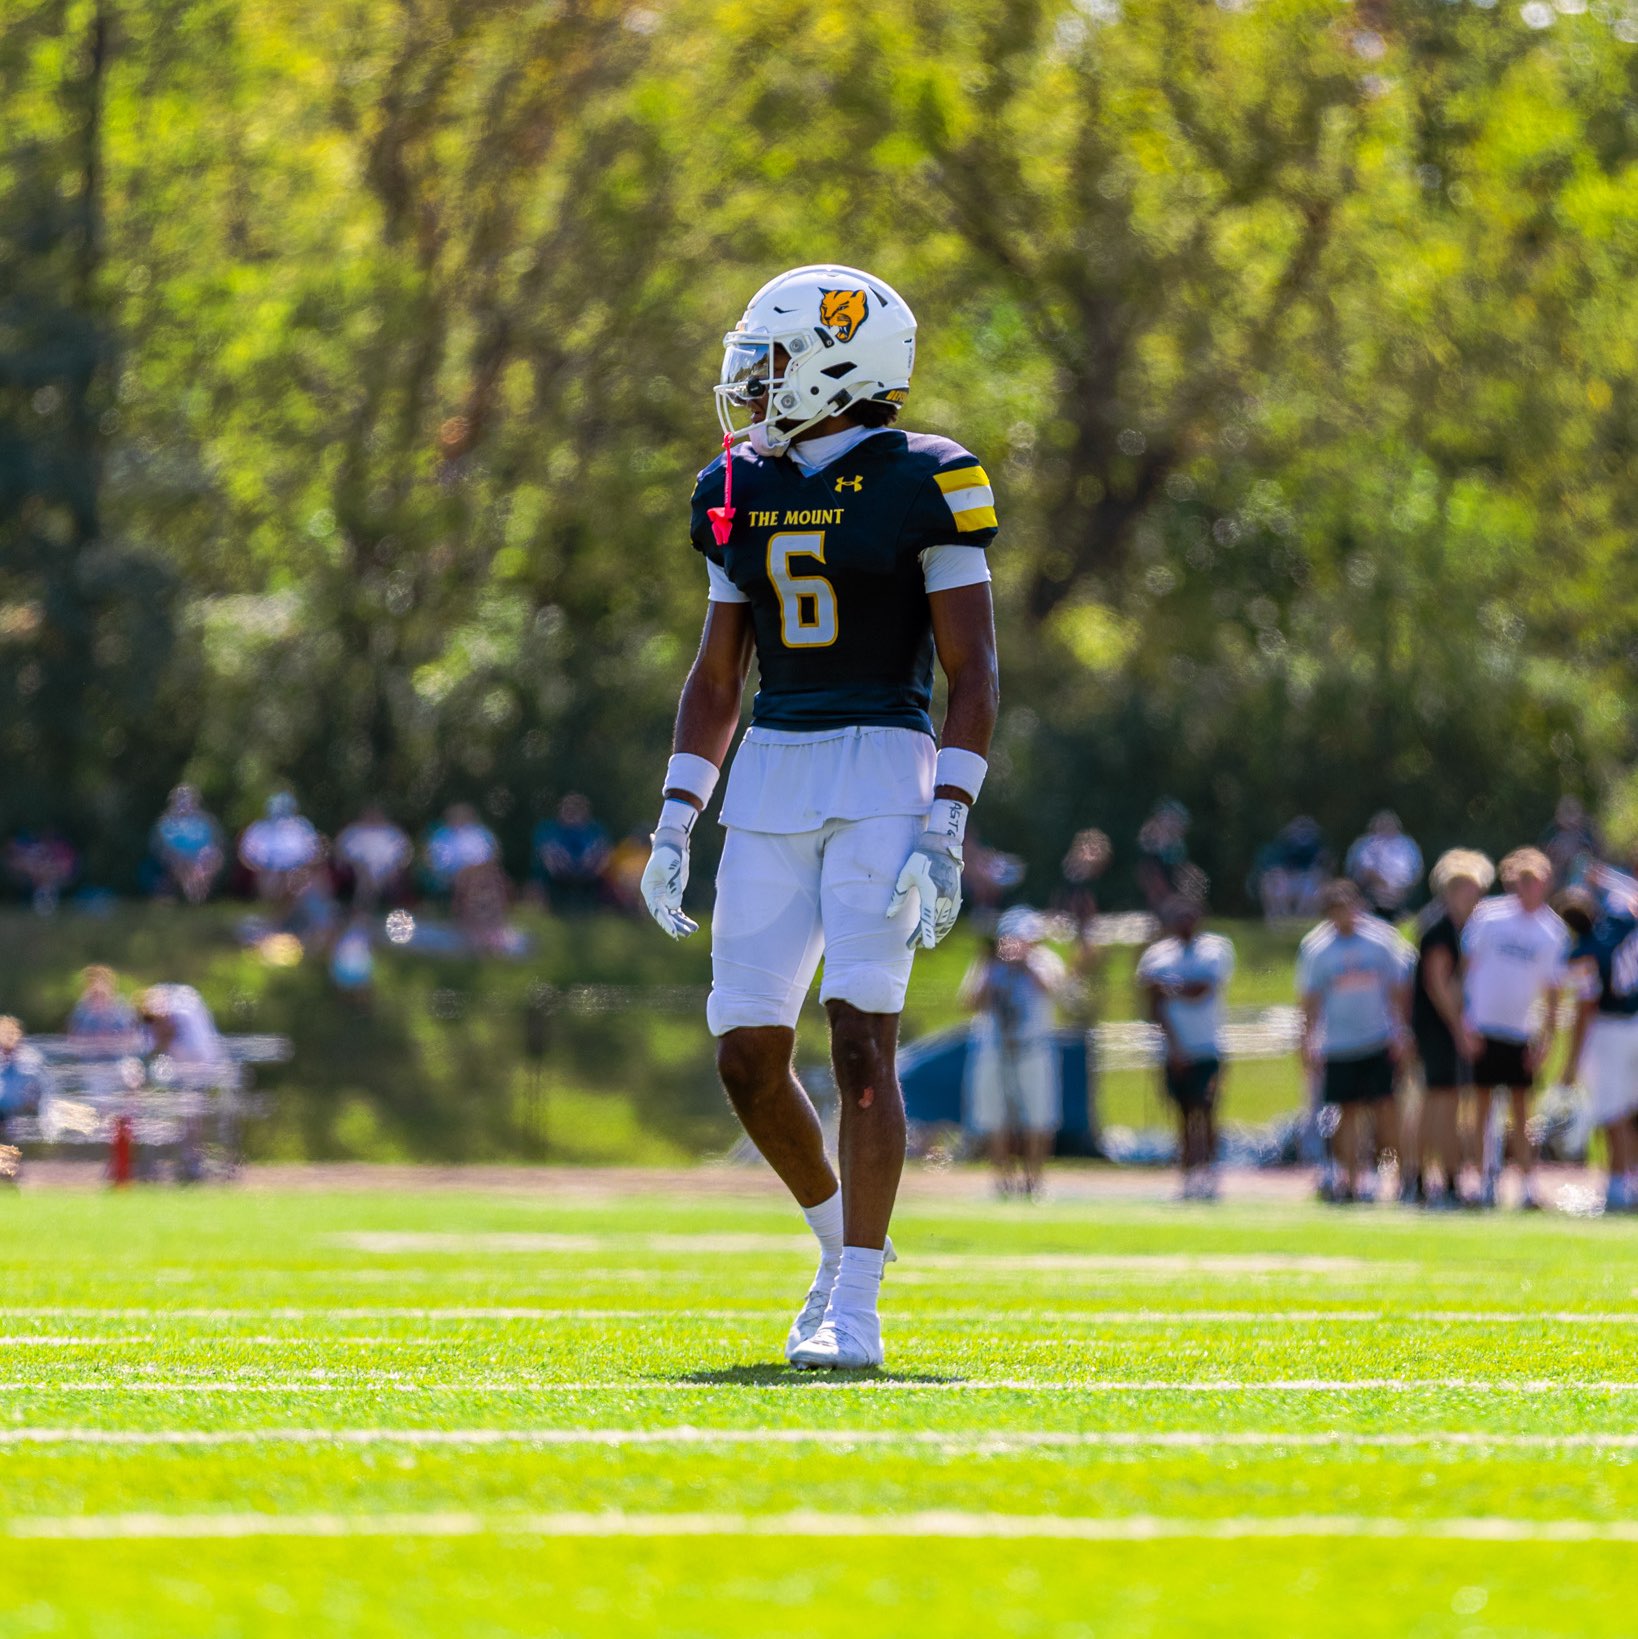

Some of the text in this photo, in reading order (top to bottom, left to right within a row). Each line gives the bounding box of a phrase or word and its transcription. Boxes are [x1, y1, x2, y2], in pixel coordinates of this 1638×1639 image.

[748, 509, 844, 527] THE MOUNT
[766, 530, 839, 648] 6
